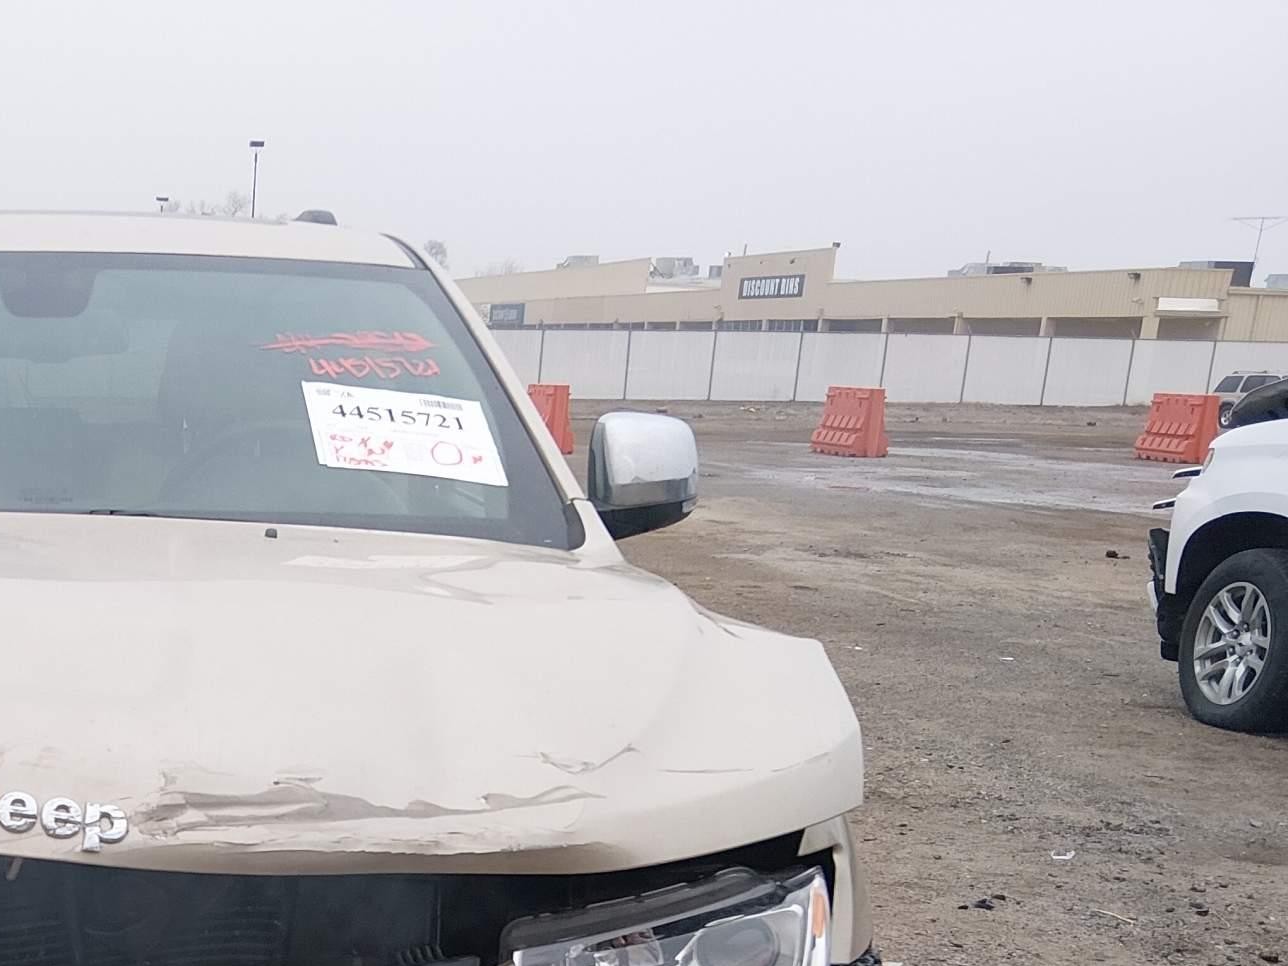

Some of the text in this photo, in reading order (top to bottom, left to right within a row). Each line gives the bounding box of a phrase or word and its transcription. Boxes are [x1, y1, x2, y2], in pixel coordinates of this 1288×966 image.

[742, 277, 800, 296] DISCOUNT BINS
[331, 403, 464, 431] 44515721
